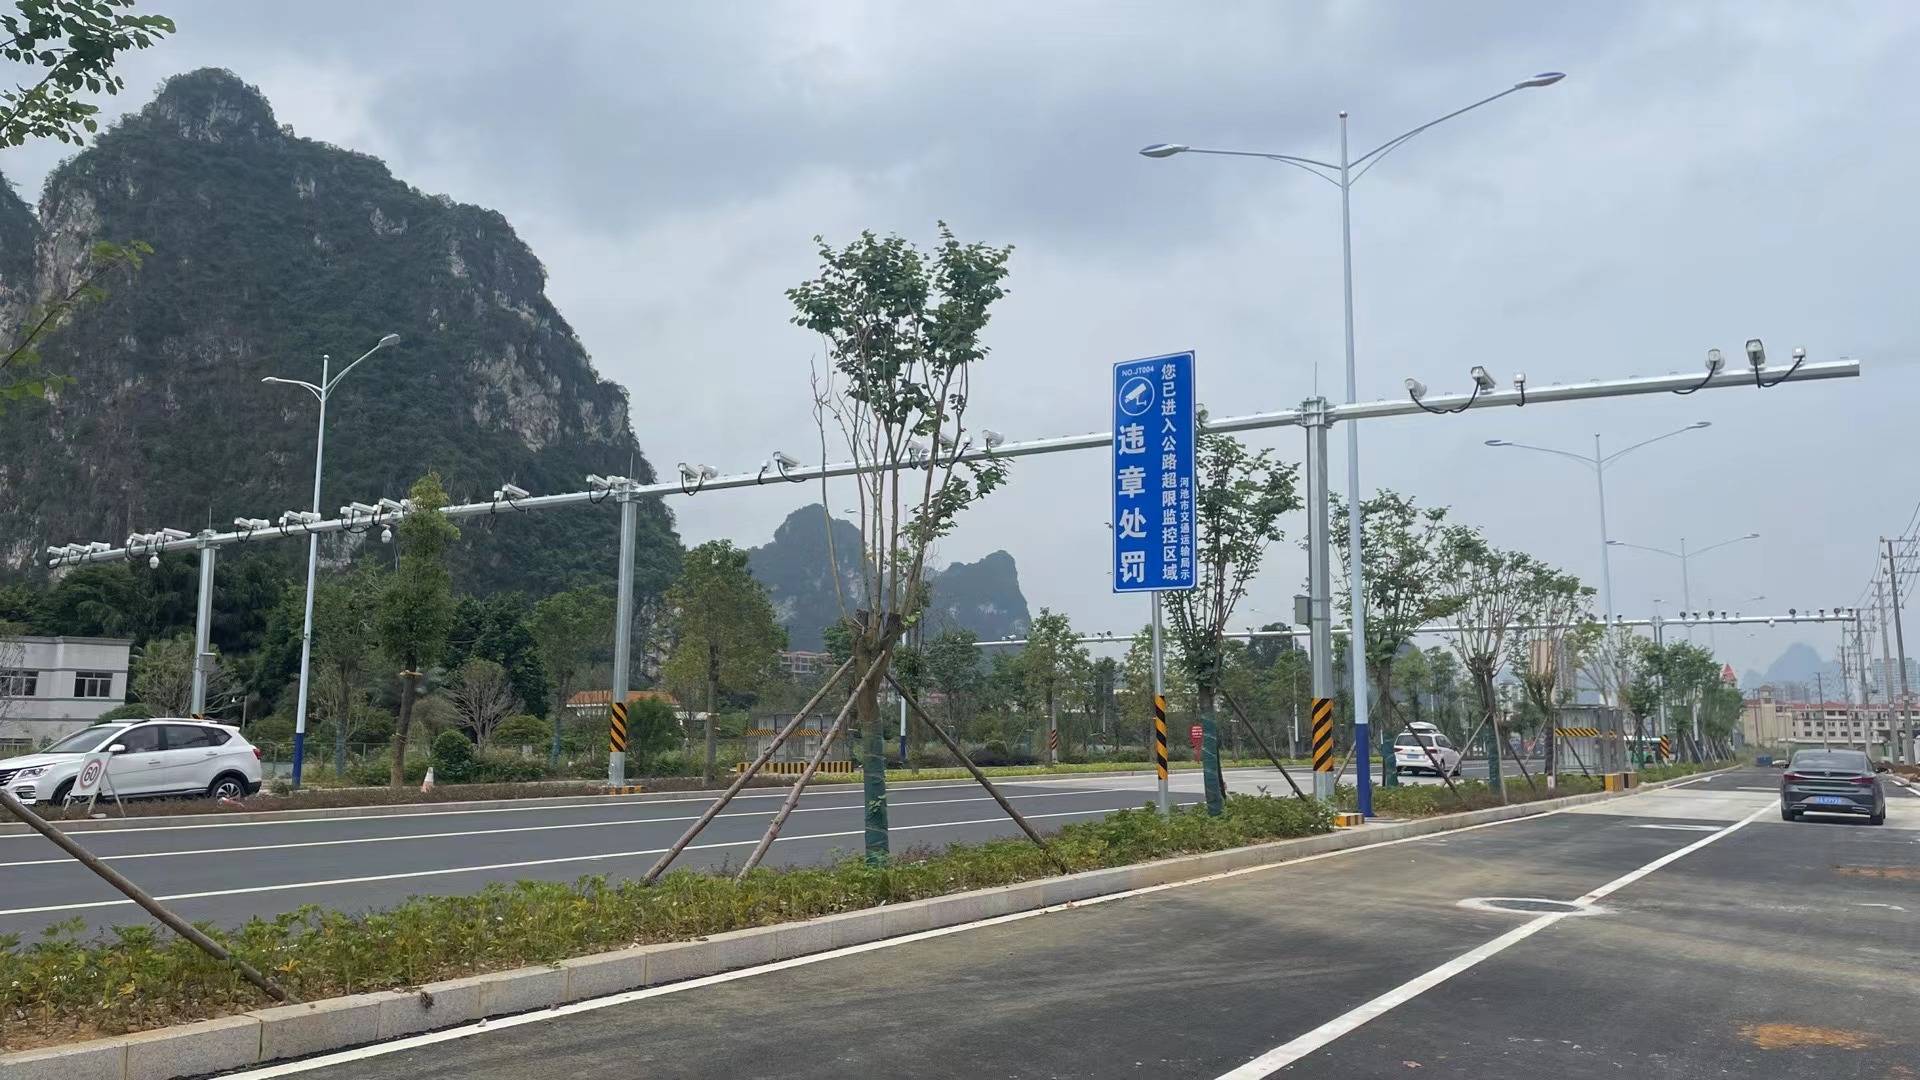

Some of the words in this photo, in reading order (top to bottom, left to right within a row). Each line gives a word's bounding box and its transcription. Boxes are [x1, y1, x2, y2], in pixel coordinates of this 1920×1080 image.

[1118, 423, 1147, 583] 违章处罚
[1161, 363, 1177, 581] 您已进入公路超限监控区域
[84, 766, 98, 781] 60
